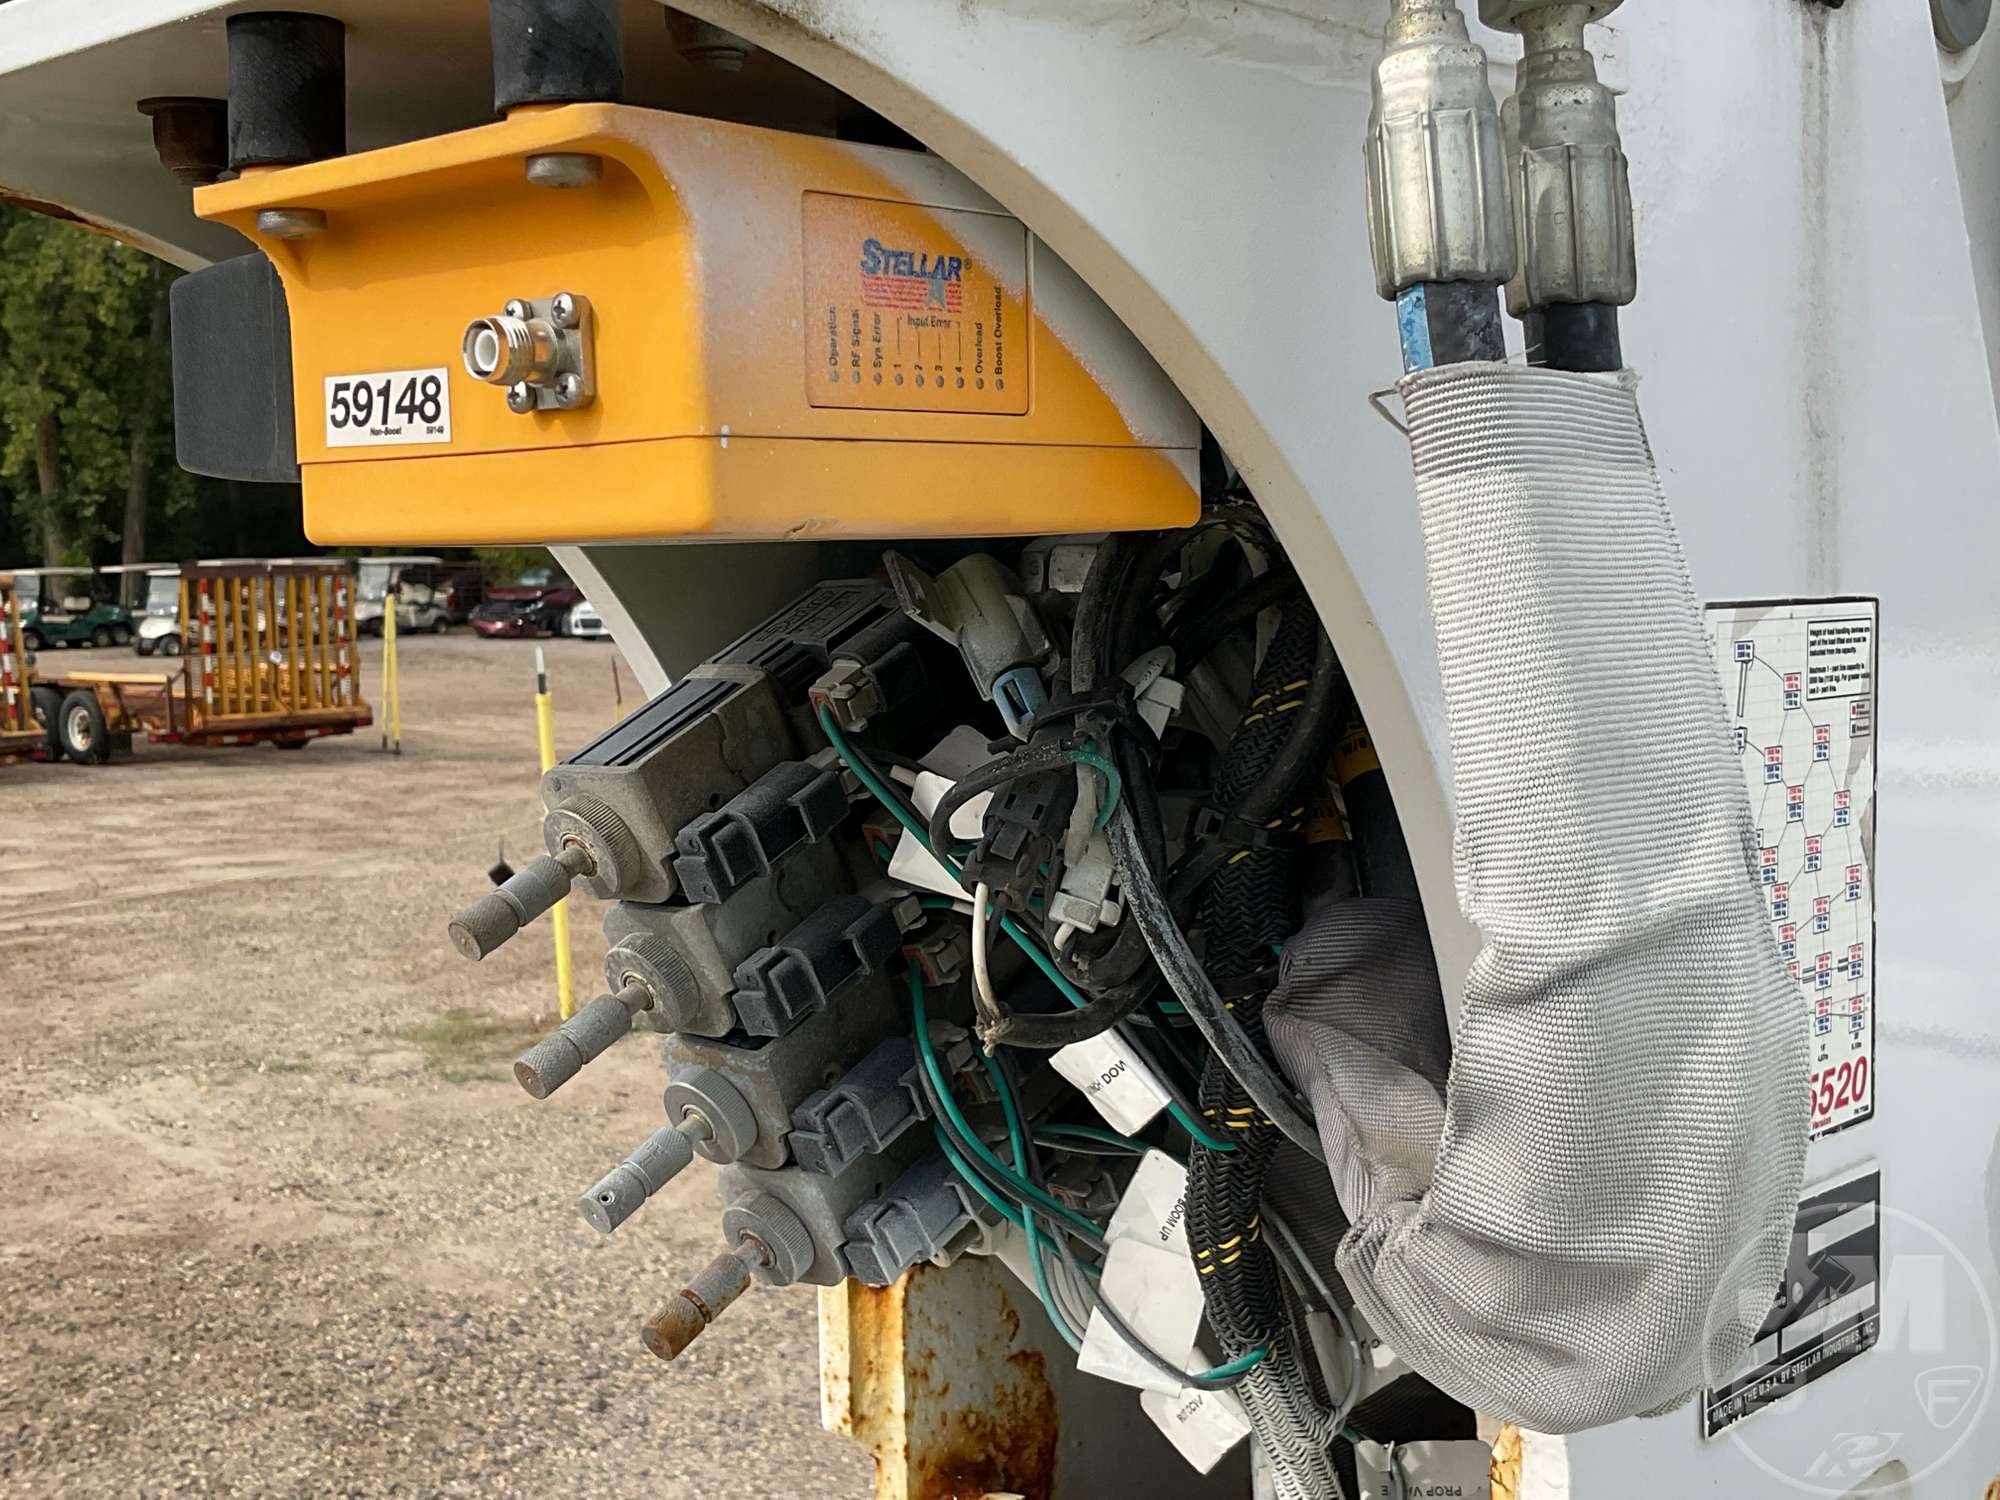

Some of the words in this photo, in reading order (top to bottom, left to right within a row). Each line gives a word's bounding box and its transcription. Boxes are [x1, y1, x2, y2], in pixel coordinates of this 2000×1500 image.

[861, 238, 963, 282] STELLAR
[872, 311, 881, 343] Error
[907, 313, 929, 330] Input
[930, 315, 951, 329] Error
[994, 286, 1002, 338] Overload
[851, 351, 861, 368] RF
[975, 322, 983, 374] Overload
[994, 342, 1003, 375] Boost
[330, 375, 441, 429] 59148
[1160, 1226, 1172, 1241] UP
[1712, 1401, 1733, 1423] MADE
[1743, 1387, 1757, 1402] THE
[1781, 1368, 1790, 1383] BY
[1791, 1351, 1821, 1377] STELLAR
[1426, 1485, 1462, 1497] PROP
